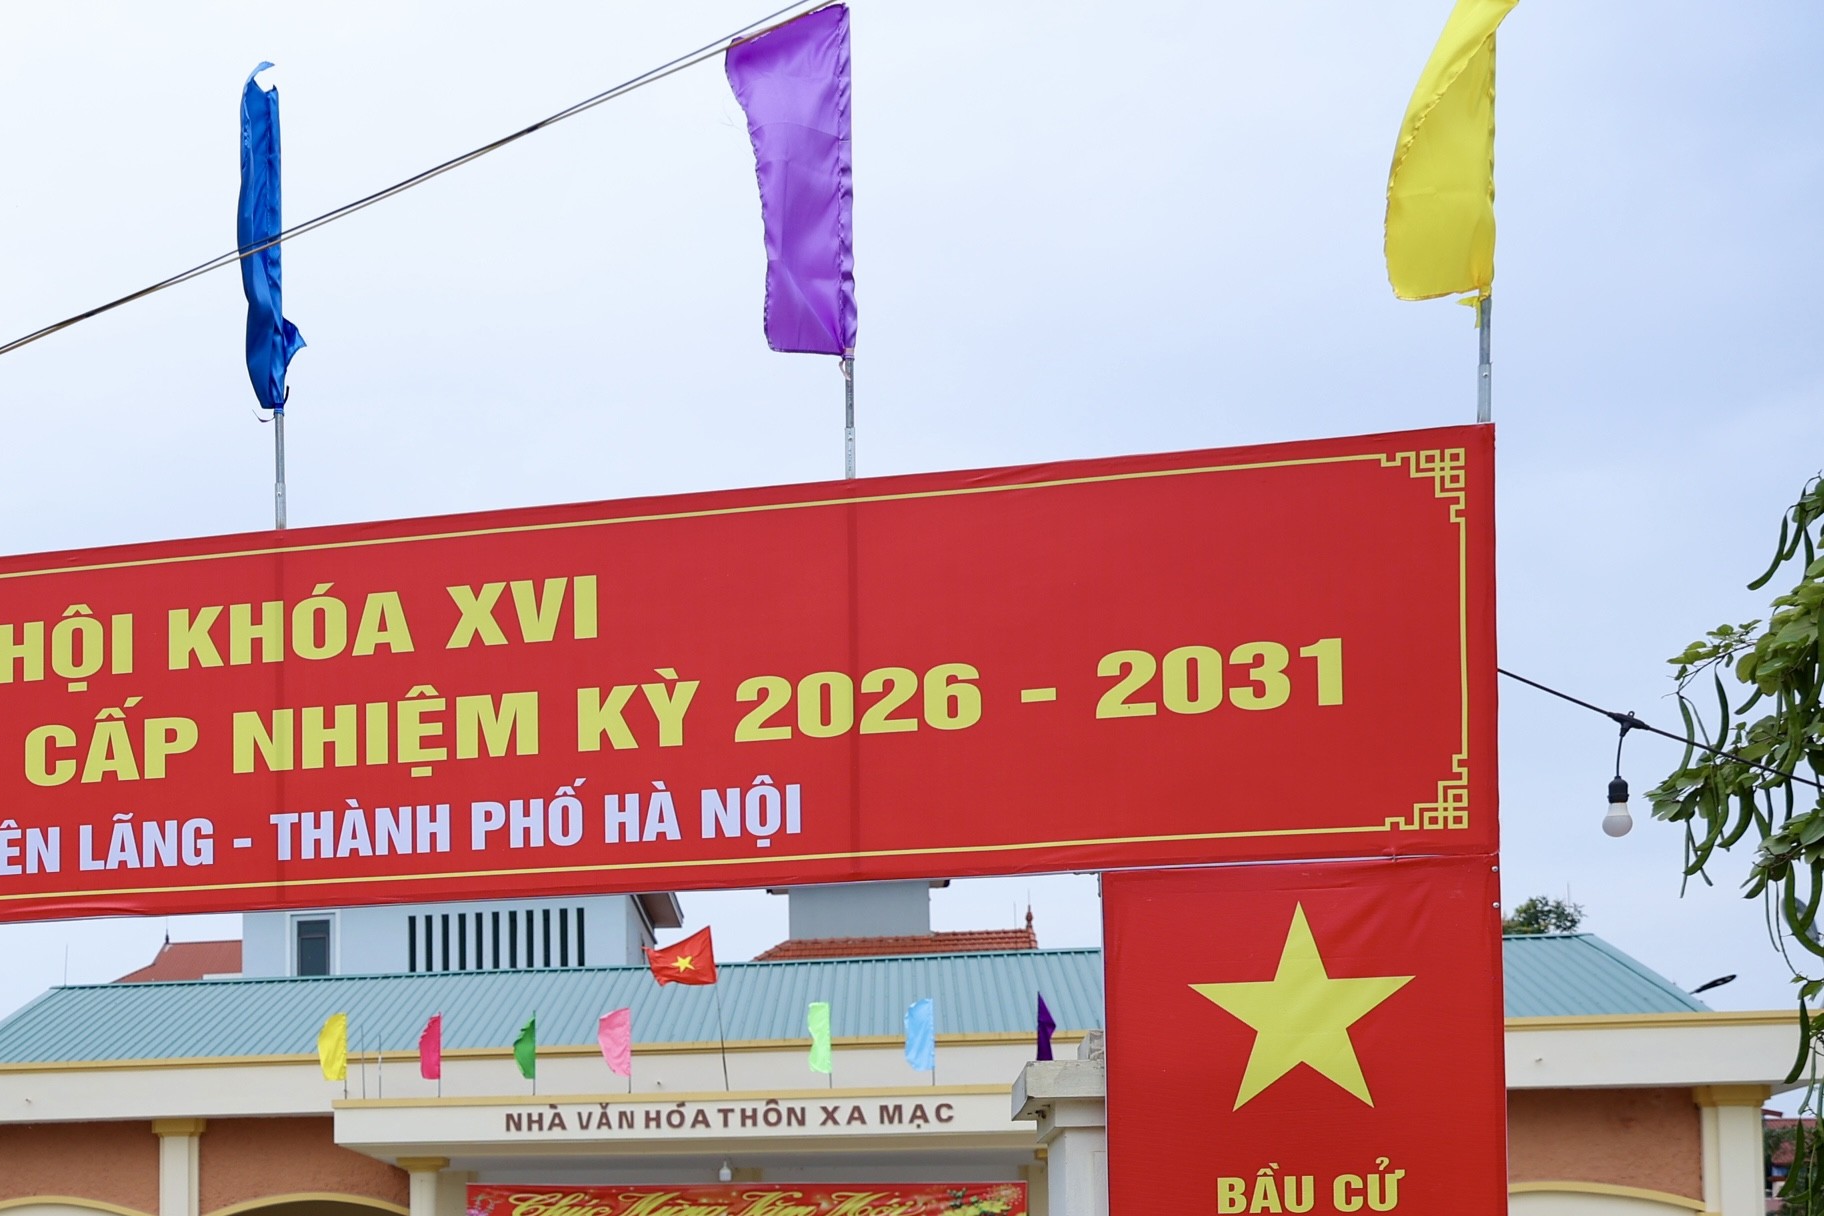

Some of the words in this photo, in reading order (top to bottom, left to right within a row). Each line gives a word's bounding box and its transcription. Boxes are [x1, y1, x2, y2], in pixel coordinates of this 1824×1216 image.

[169, 583, 414, 670] KHÓA
[446, 575, 597, 649] XVI
[25, 696, 198, 786] CẤP
[233, 685, 538, 777] NHIỆM
[577, 668, 700, 752] KỲ
[735, 663, 981, 742] 2026
[1096, 638, 1343, 719] 2031
[80, 813, 213, 870] LÃNG
[270, 799, 450, 860] THÀNH
[472, 778, 586, 850] PHỐ
[605, 781, 681, 843] HÀ
[702, 775, 800, 847] NỘI
[505, 1104, 567, 1132] NHÀ
[577, 1102, 635, 1130] VĂN
[644, 1102, 711, 1129] HÓA
[717, 1099, 806, 1129] THÔN
[819, 1105, 867, 1126] XA
[879, 1103, 954, 1129] MẠC
[1218, 1163, 1314, 1214] BẦU
[1334, 1157, 1405, 1212] CỬ
